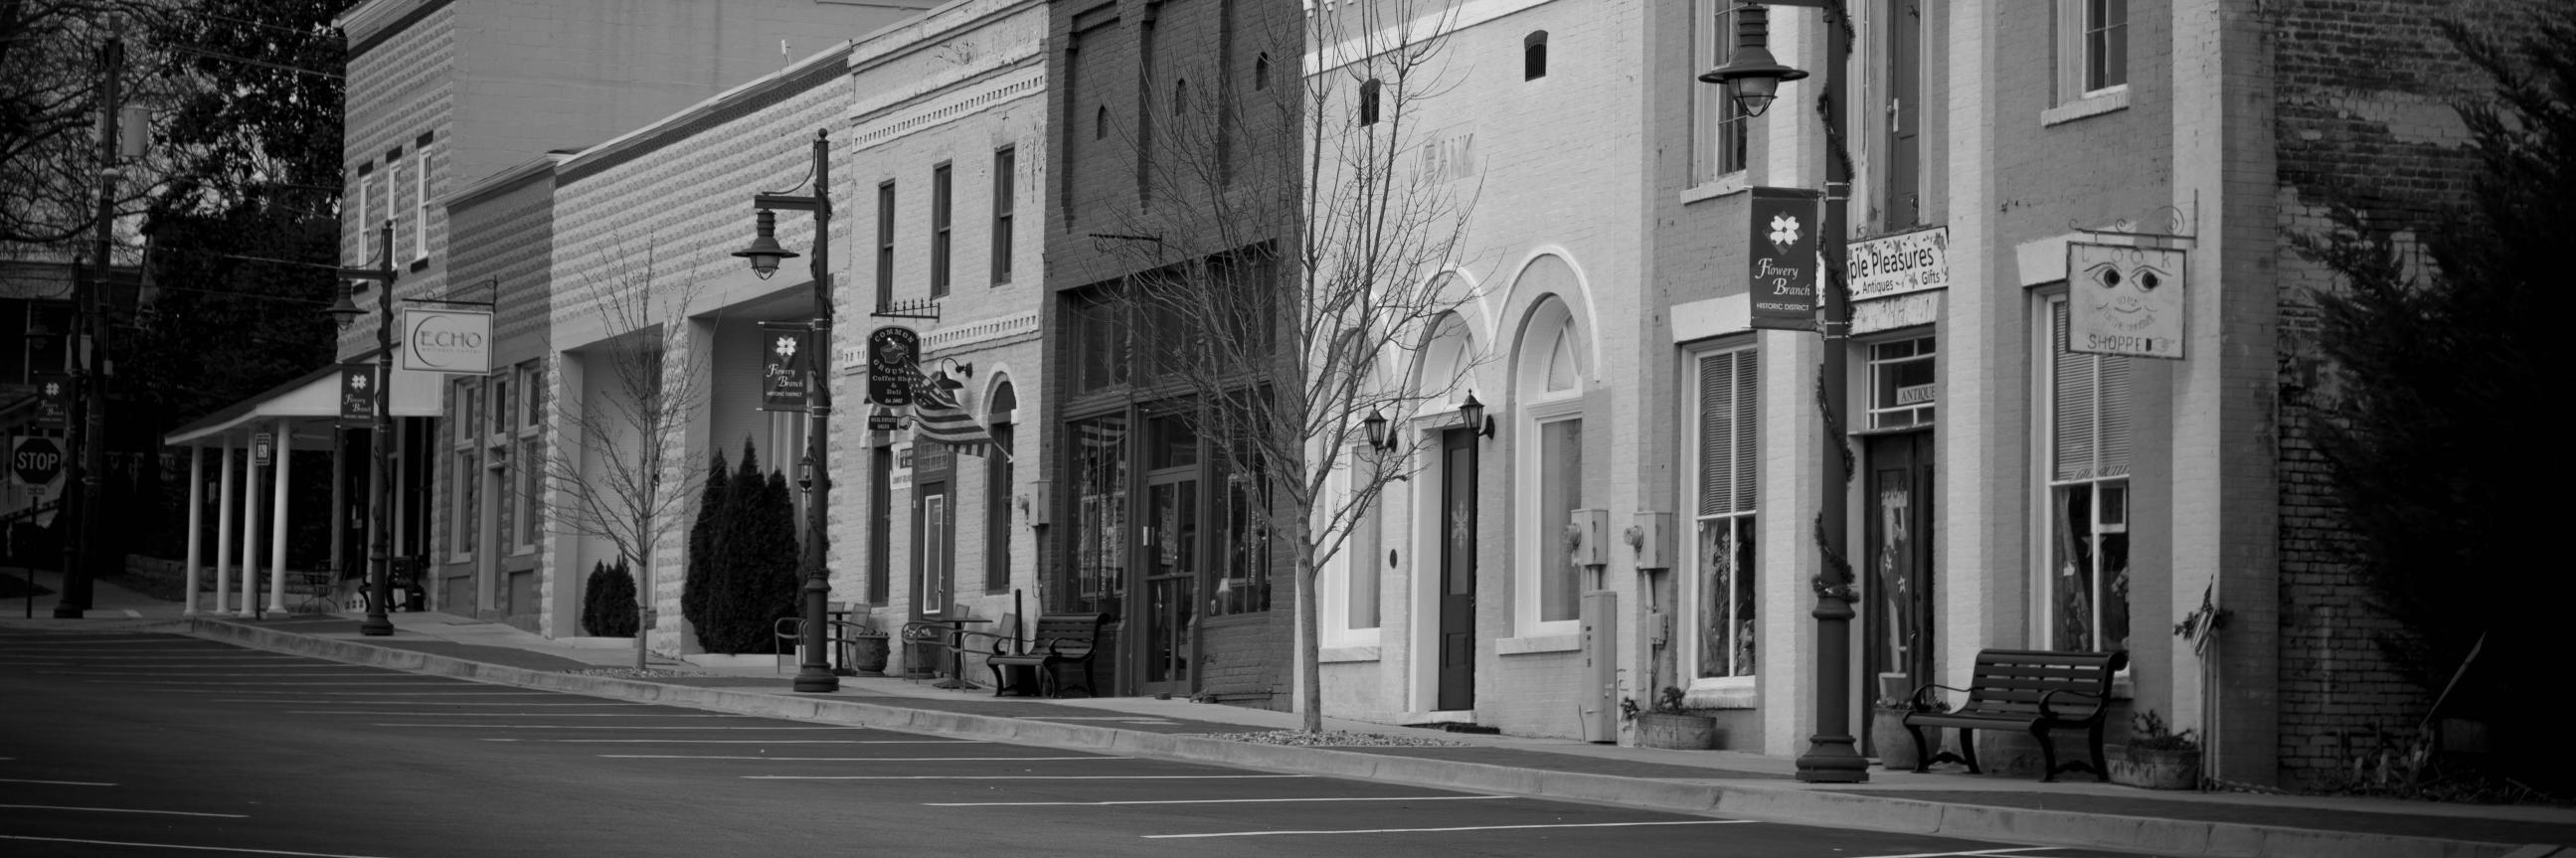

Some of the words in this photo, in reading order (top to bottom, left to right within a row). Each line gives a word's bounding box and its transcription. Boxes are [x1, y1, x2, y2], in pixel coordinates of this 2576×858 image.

[1872, 247, 1935, 276] Pleasures
[2081, 244, 2172, 269] LOOK
[1755, 257, 1799, 279] Flowery
[1773, 277, 1810, 296] Branch
[1862, 278, 1894, 295] Antiques
[1921, 269, 1941, 285] Gifts
[1756, 302, 1784, 311] HISTORIC
[421, 330, 482, 349] ECHO
[874, 328, 915, 343] COMMON
[2087, 333, 2143, 352] SHOPPE
[767, 363, 795, 378] Flowery
[778, 375, 803, 388] Branch
[17, 451, 58, 470] STOP
